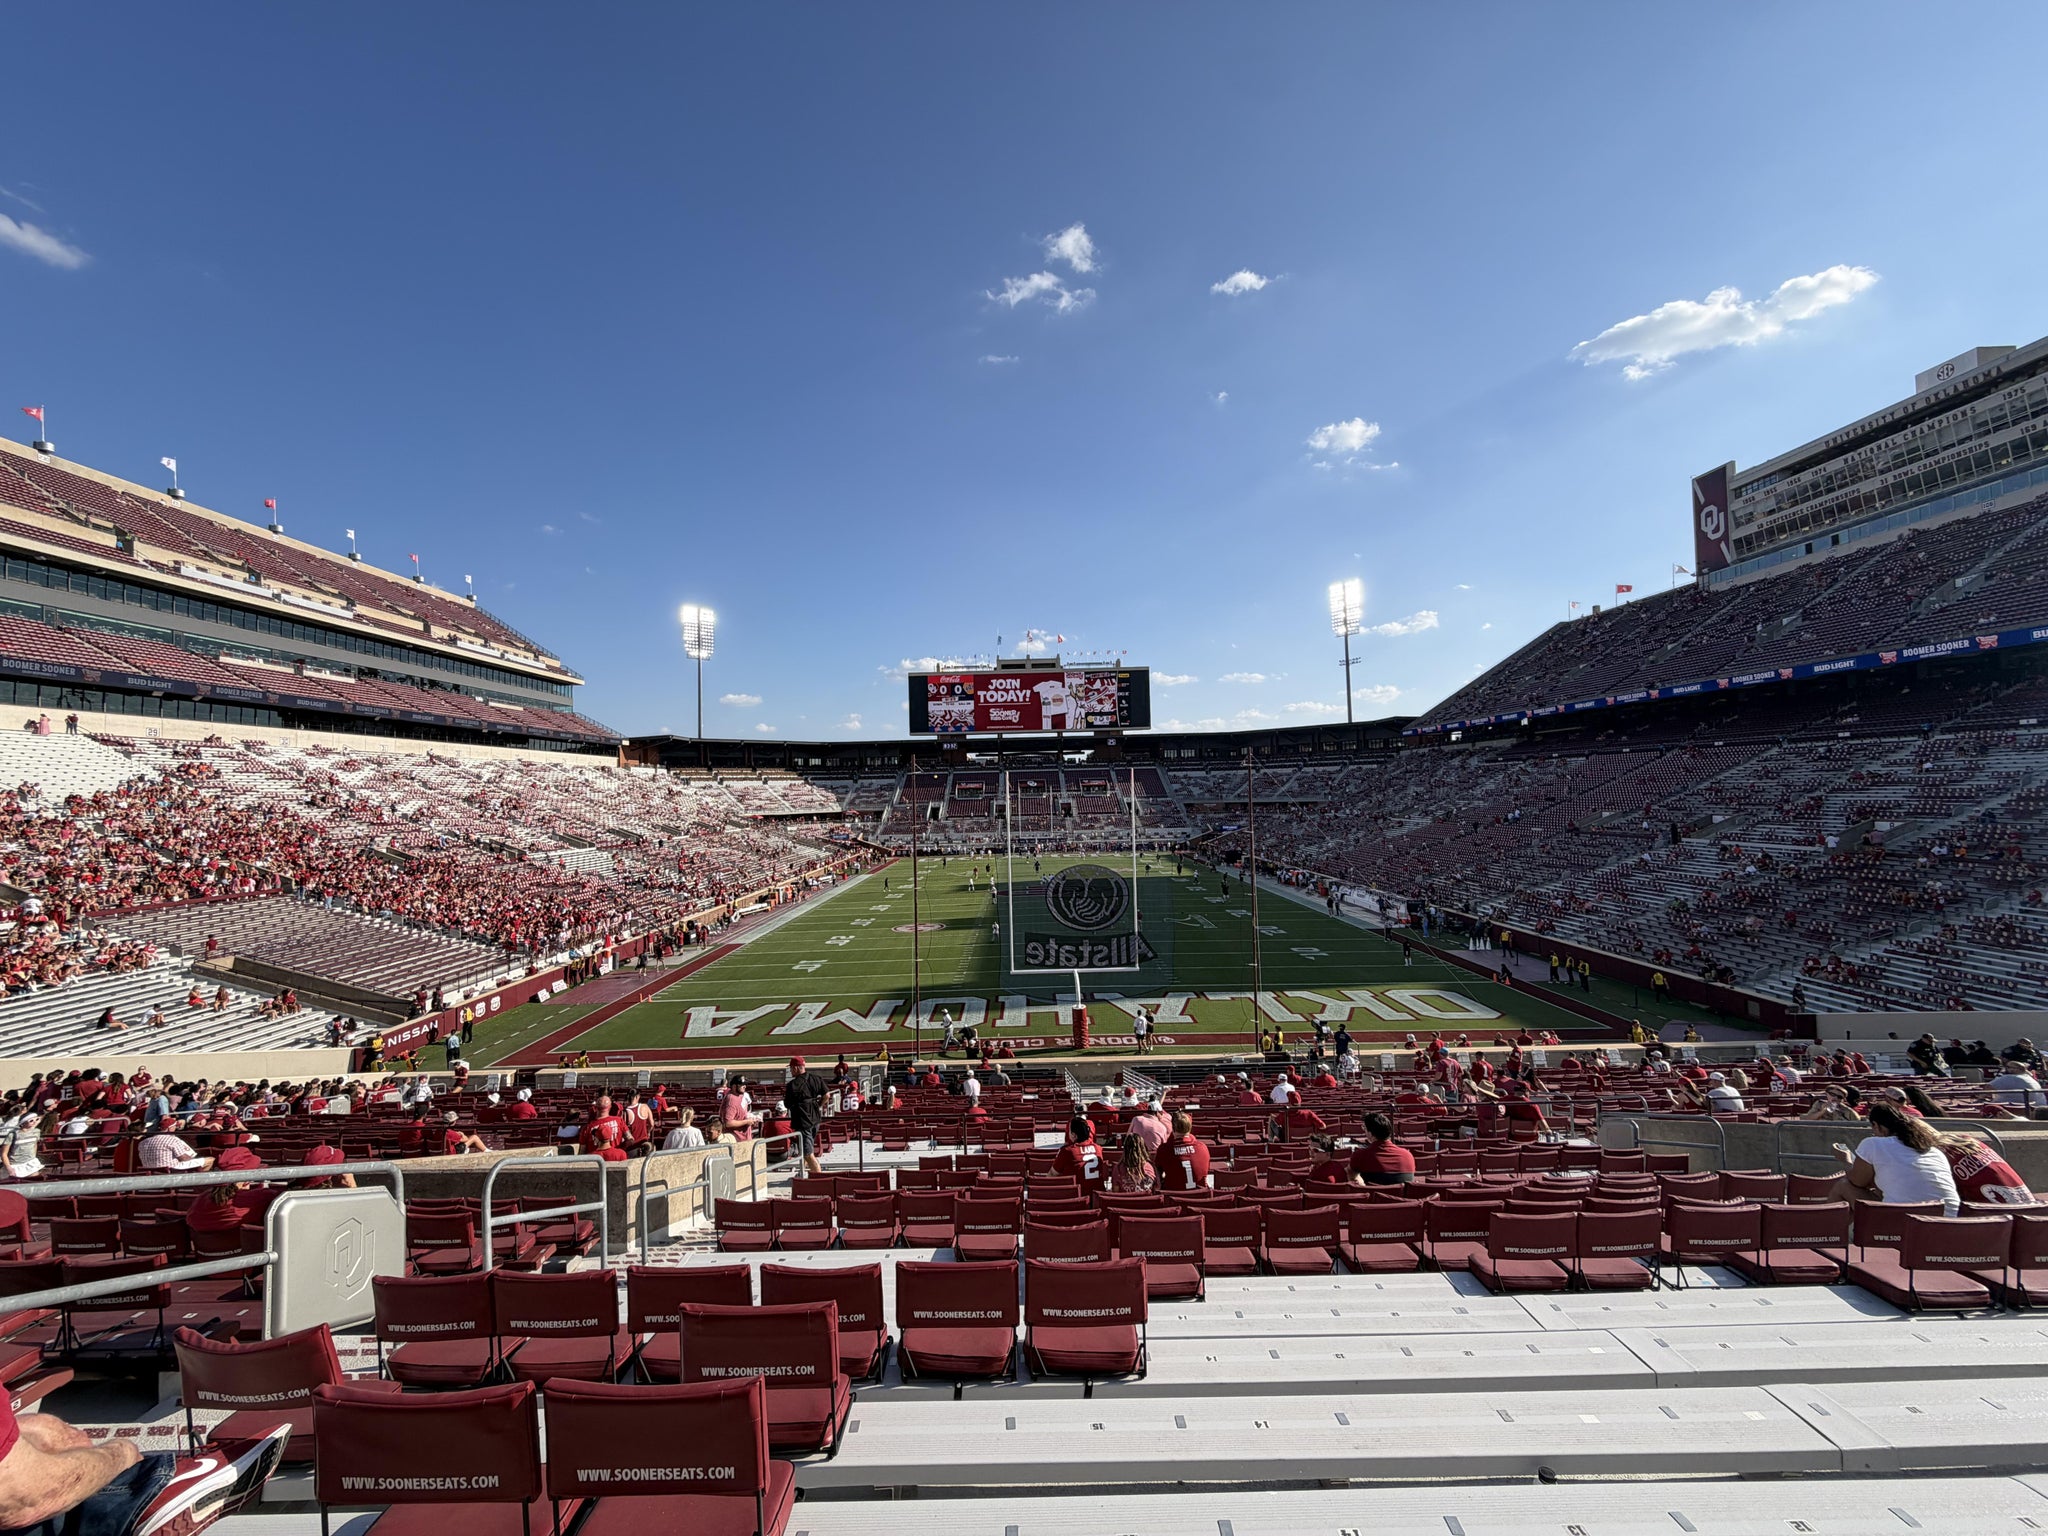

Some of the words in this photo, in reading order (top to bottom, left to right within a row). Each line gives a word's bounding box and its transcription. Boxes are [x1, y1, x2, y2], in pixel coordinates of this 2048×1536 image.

[1938, 365, 1955, 380] SEC
[1824, 411, 1896, 450] UNIVERSITY
[1902, 402, 1918, 415] OF
[1924, 366, 2003, 406] OKLAHOMA
[1843, 438, 1898, 465] NATIONAL
[1903, 406, 1977, 440] CHAMPIONS
[2002, 386, 2027, 401] 1975
[1806, 488, 1861, 514] CHAMPIONSHIPS
[1893, 468, 1915, 481] BOWL
[1917, 441, 1990, 471] CHAMPIONSHIPS
[1700, 504, 1726, 541] OU
[1903, 643, 1936, 657] BOOMER
[1936, 639, 1970, 652] SOONER
[2, 658, 41, 672] BOOMER
[42, 664, 76, 676] SOONER
[1814, 664, 1831, 672] BUD
[1831, 660, 1855, 670] LIGHT
[127, 677, 148, 687] BUD
[148, 679, 173, 689] LIGHT
[940, 685, 947, 694] 0
[954, 685, 962, 694] 0
[988, 679, 1021, 690] JOIN
[216, 686, 240, 697] BOOMER
[241, 689, 263, 699] SOONER
[977, 690, 1031, 703] TODAY!
[685, 989, 1503, 1038] OKLAHOMA
[387, 1020, 438, 1047] NISSAN
[1770, 1080, 1785, 1092] 65
[1174, 1145, 1195, 1156] HURTS
[1083, 1154, 1099, 1180] 2
[1182, 1160, 1197, 1189] 1
[1440, 1231, 1489, 1239] WWW.SOONERSEATS.C
[1777, 1235, 1840, 1244] WWW.SOONERSEATS.COM
[1592, 1243, 1655, 1252] WWW.SOONERSEATS.COM
[1689, 1238, 1752, 1247] WWW.SOONERSEATS.COM
[1131, 1249, 1195, 1258] WWW.SOONERSEATS.COM
[1504, 1246, 1568, 1254] WWW.SOONERSEATS.COM
[1925, 1255, 2000, 1263] WWW.SOONERSEATS.COM
[913, 1309, 1003, 1320] WWW.SOONERSEATS.COM
[1042, 1306, 1132, 1318] WWW.SOONERSEATS.COM
[388, 1320, 476, 1333] WWW.SOONERSEATS.COM
[510, 1318, 599, 1329] WWW.SOONERSEATS.COM
[701, 1365, 816, 1378] WWW.SOONERSEATS.COM
[197, 1388, 310, 1404] WWW.SOONERSEATS.COM
[1092, 1422, 1103, 1430] 15
[1254, 1421, 1269, 1429] 14
[577, 1466, 735, 1482] WWW.SOONERSEATS.COM
[342, 1475, 499, 1491] WWW.SOONERSEATS.COM
[1790, 1520, 1813, 1533] 12
[2021, 1516, 2042, 1529] 11
[1568, 1525, 1588, 1536] 13
